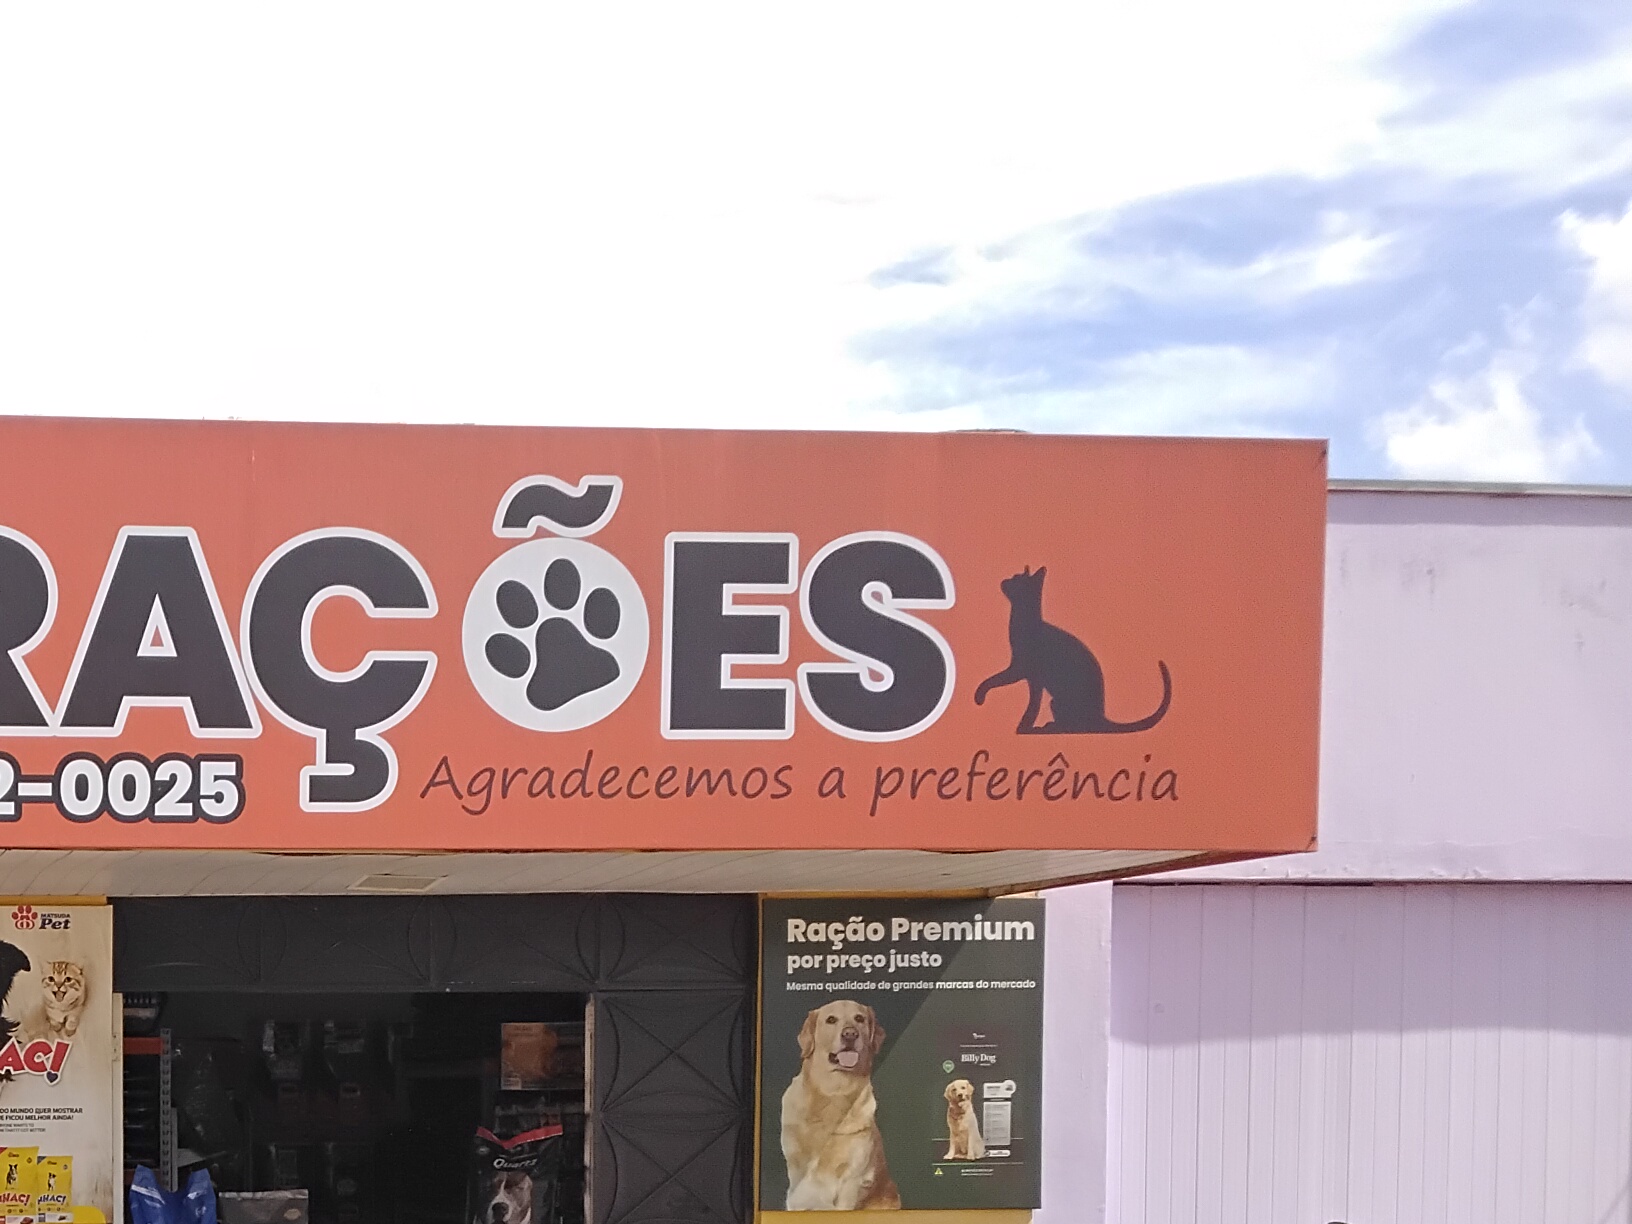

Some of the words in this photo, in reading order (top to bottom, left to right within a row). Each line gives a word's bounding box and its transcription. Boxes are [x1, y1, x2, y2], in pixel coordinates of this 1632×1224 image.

[420, 751, 794, 817] Agradecemos
[818, 764, 847, 801] a
[868, 751, 1180, 816] preferência
[39, 919, 71, 930] Pet
[787, 916, 885, 950] Ração
[891, 914, 1035, 941] Premium
[787, 954, 823, 974] por
[826, 953, 886, 973] preço
[888, 949, 943, 973] justo
[786, 981, 823, 991] Mesma
[825, 980, 876, 993] qualidade
[877, 980, 891, 990] de
[893, 980, 934, 992] grandes
[936, 980, 974, 990] marcas
[975, 979, 989, 989] do
[990, 979, 1036, 990] mercado
[35, 1107, 51, 1115] QUER
[493, 1158, 537, 1169] Quartz
